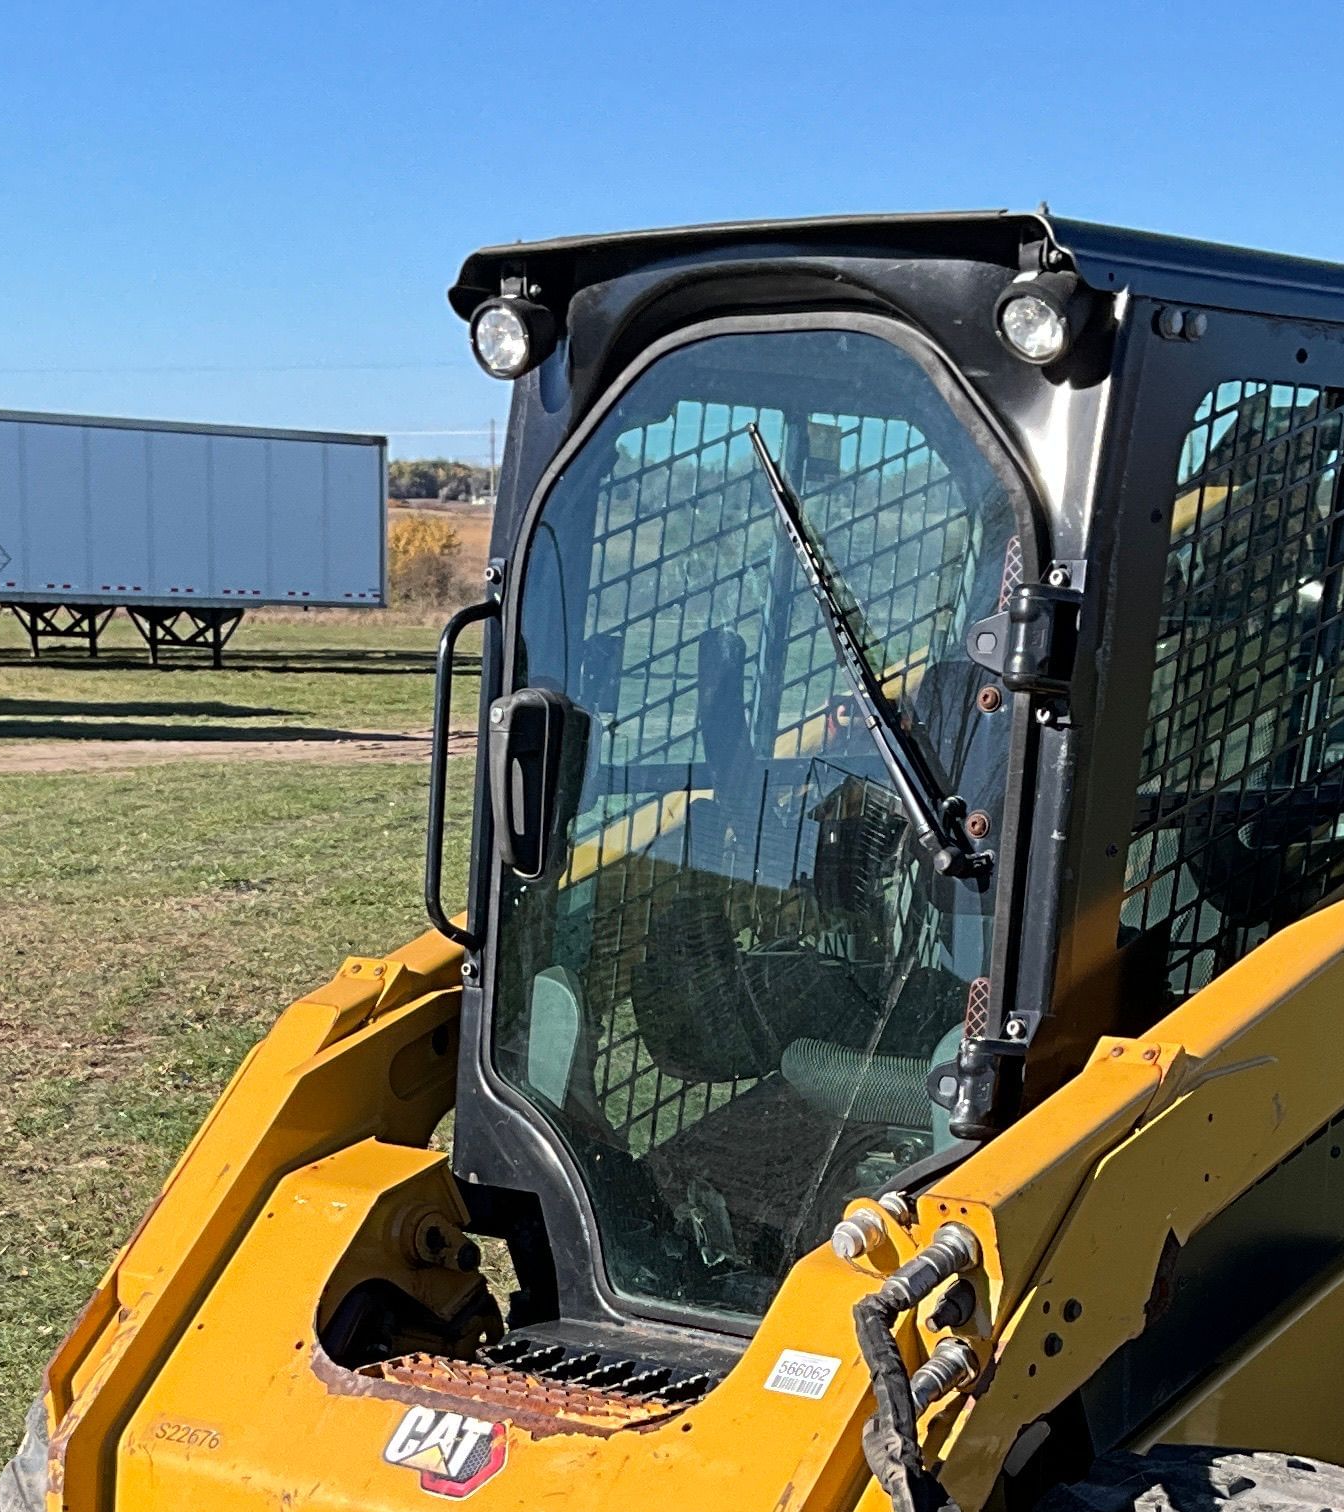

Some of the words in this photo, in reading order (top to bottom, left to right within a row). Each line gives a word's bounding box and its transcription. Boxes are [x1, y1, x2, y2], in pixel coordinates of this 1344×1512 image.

[778, 1360, 831, 1382] 566062
[155, 1421, 221, 1450] S22676
[385, 1403, 494, 1477] CAT
